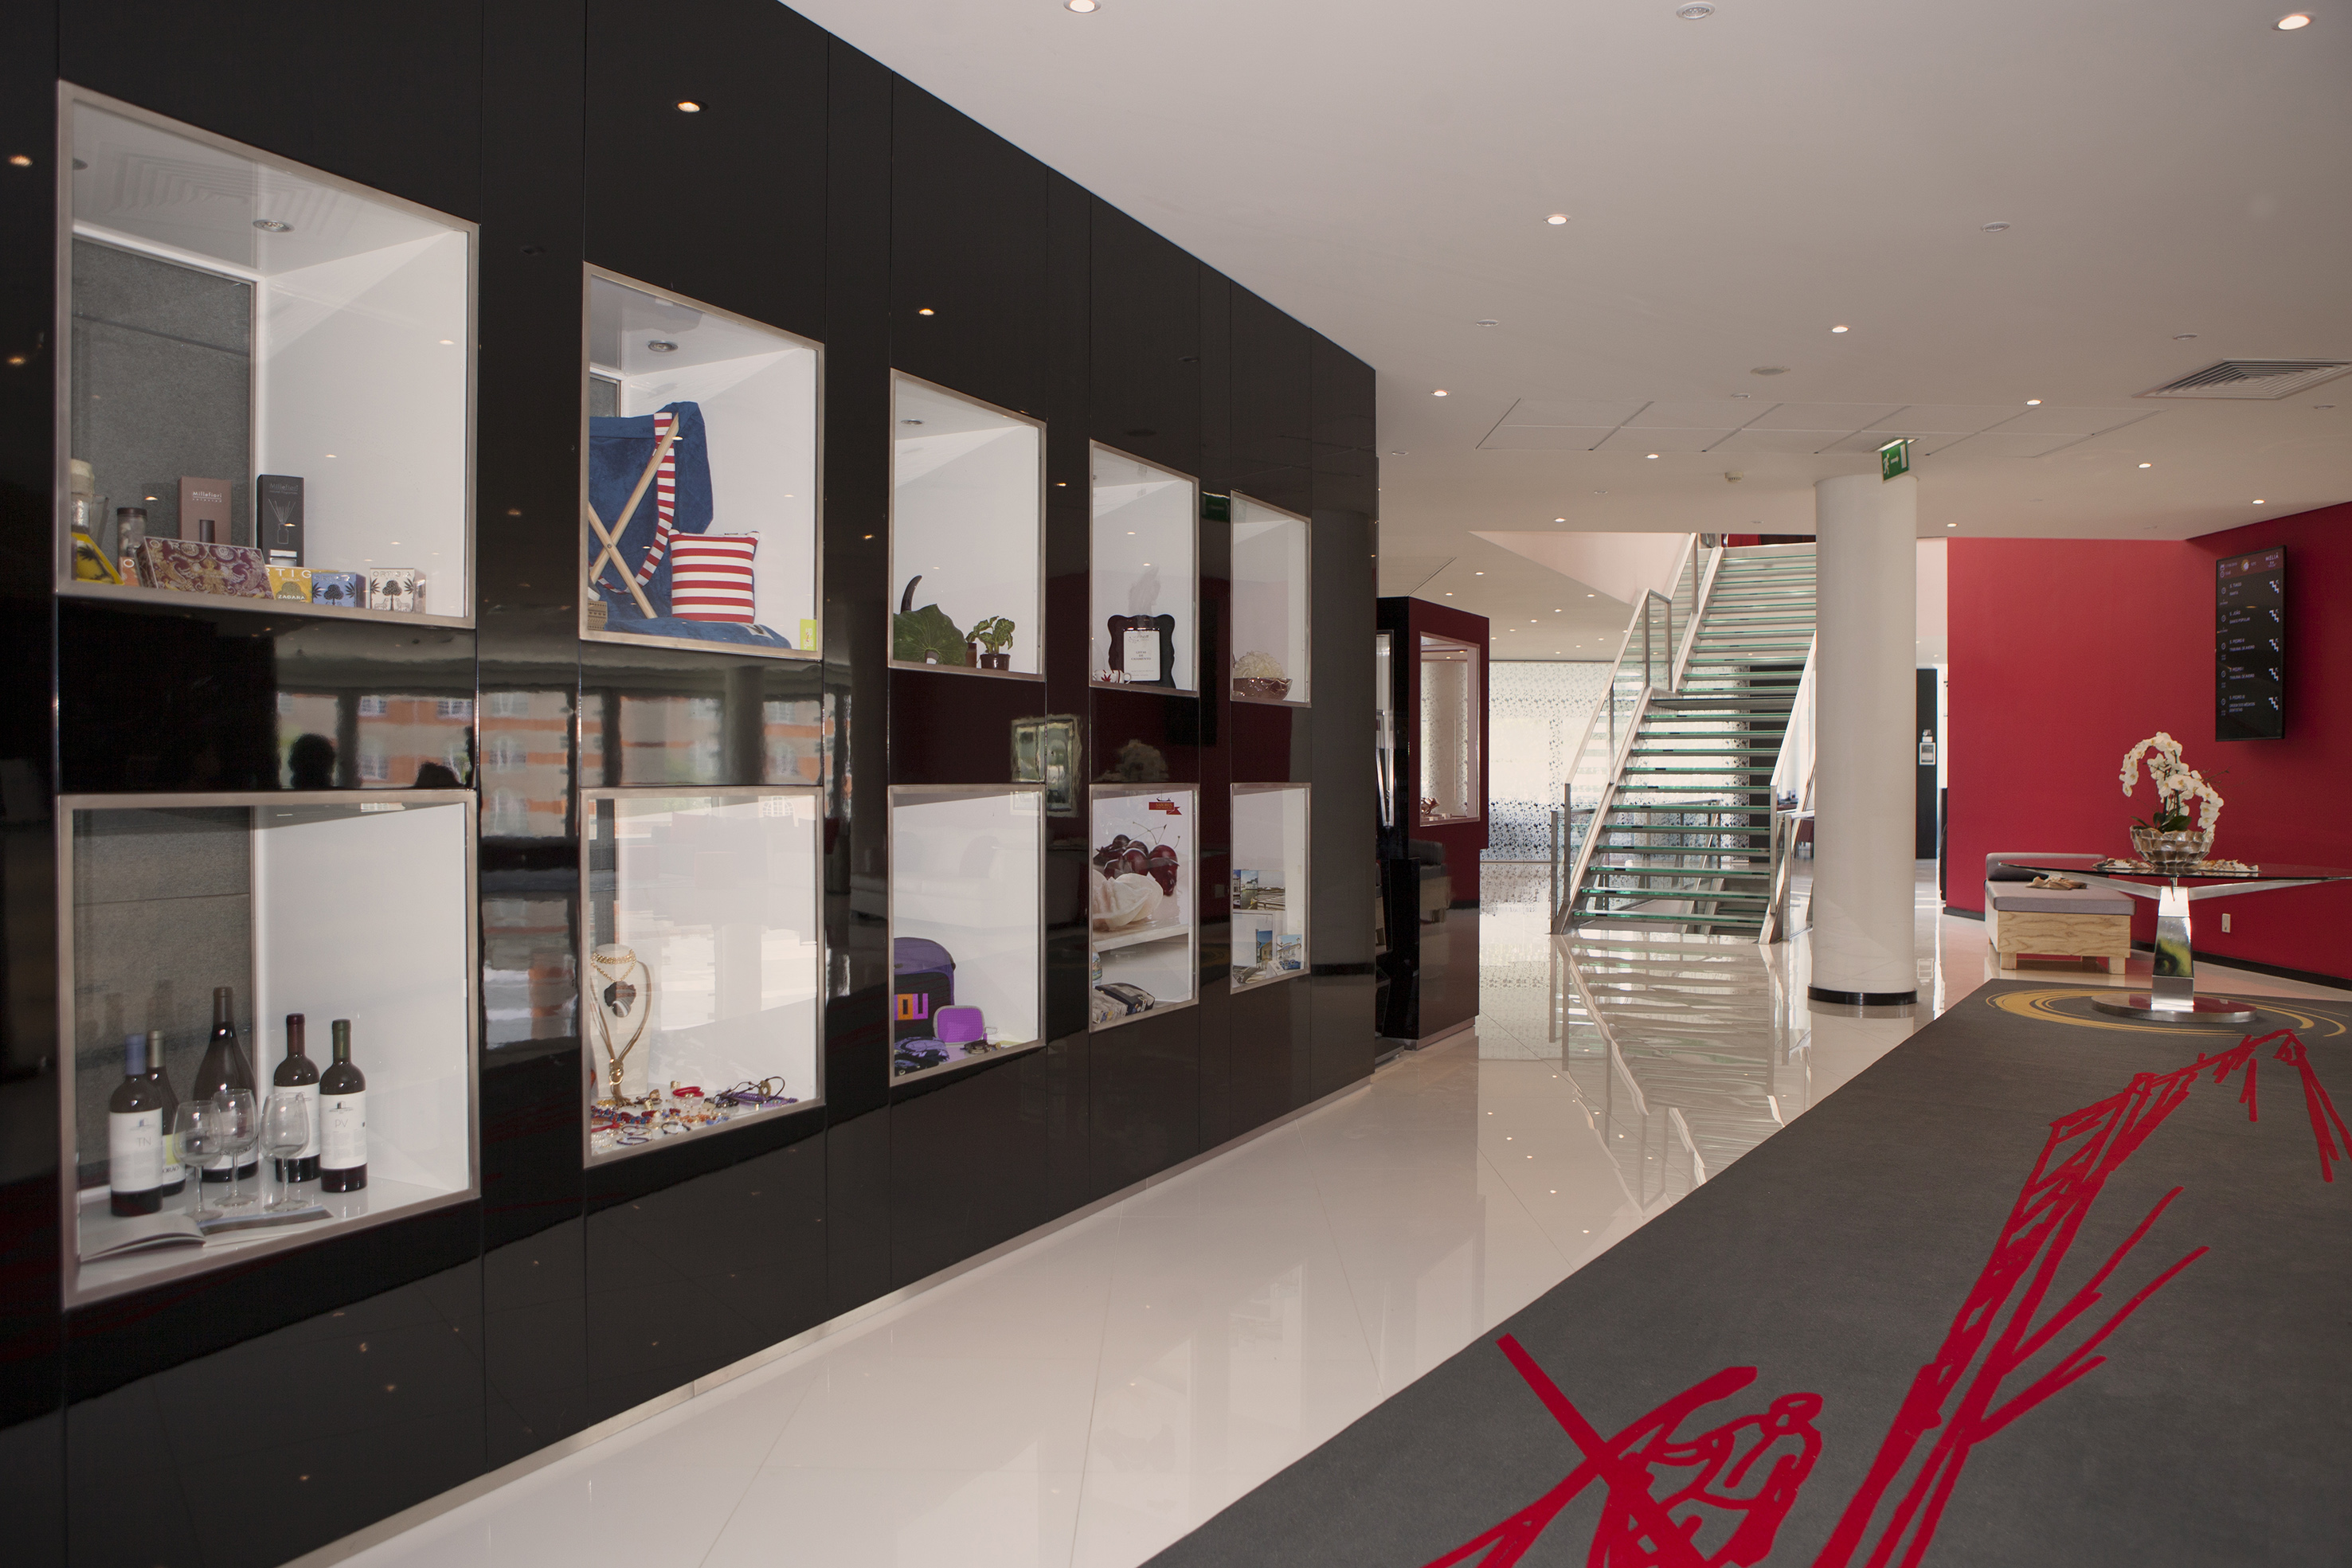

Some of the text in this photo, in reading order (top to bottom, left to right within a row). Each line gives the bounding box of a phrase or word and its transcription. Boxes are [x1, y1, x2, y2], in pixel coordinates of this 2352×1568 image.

[894, 993, 929, 1021] OU
[335, 1119, 348, 1128] PV
[137, 1137, 151, 1147] TN
